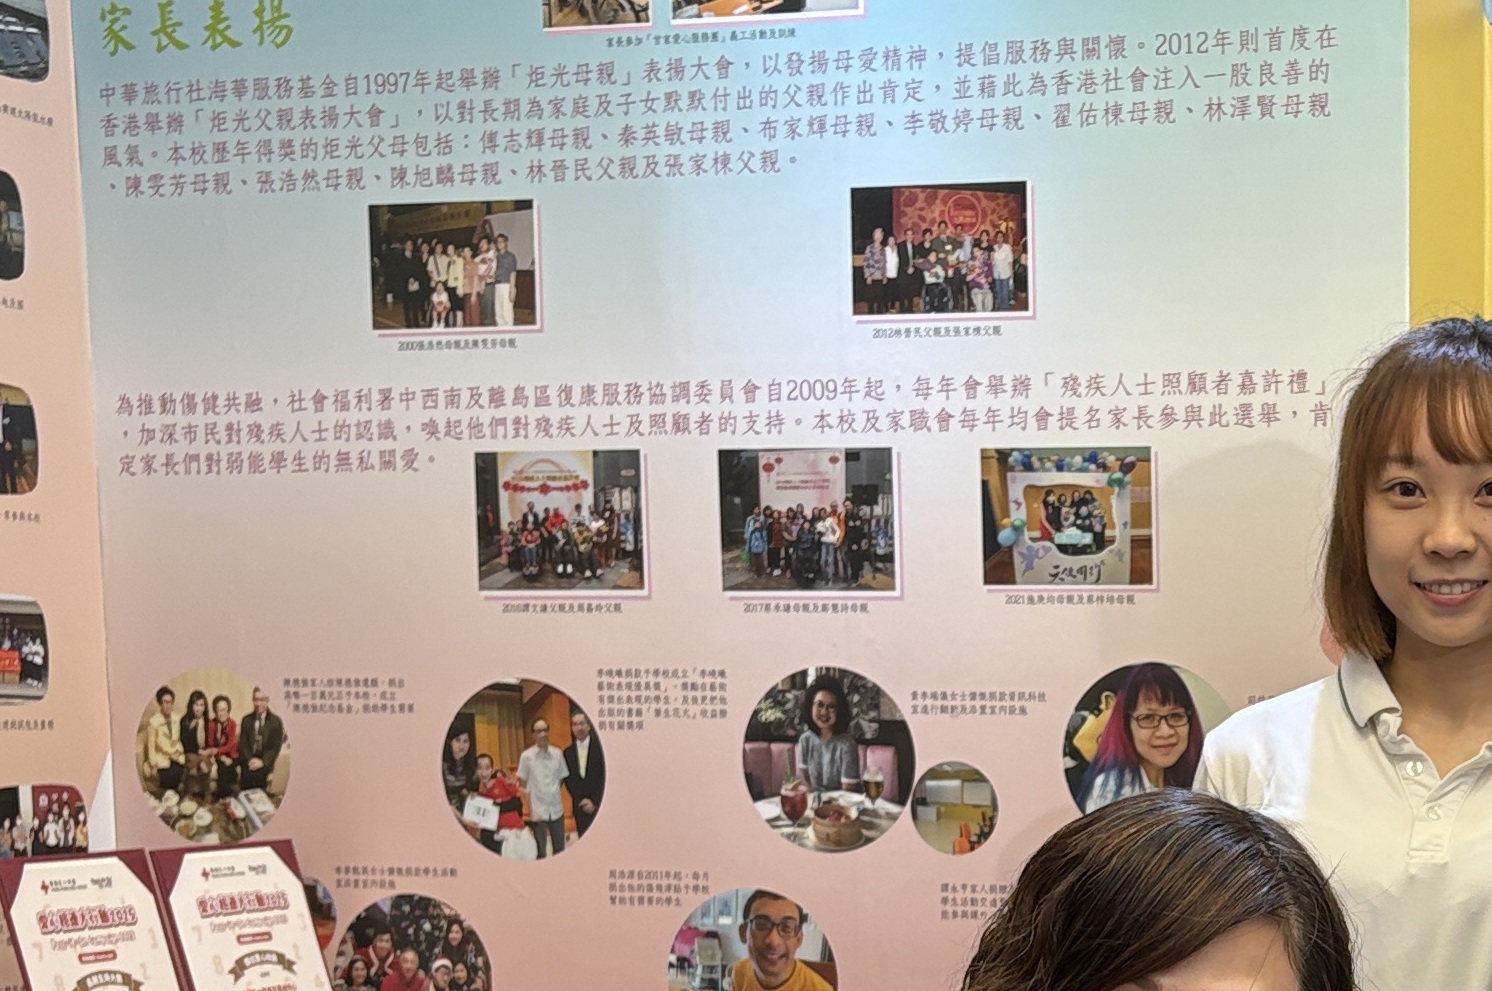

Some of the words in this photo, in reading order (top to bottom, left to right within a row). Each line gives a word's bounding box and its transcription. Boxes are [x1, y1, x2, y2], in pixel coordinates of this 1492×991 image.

[99, 0, 295, 57] 家長表揚
[118, 446, 437, 477] 定家長們對弱能學生的無私關愛。
